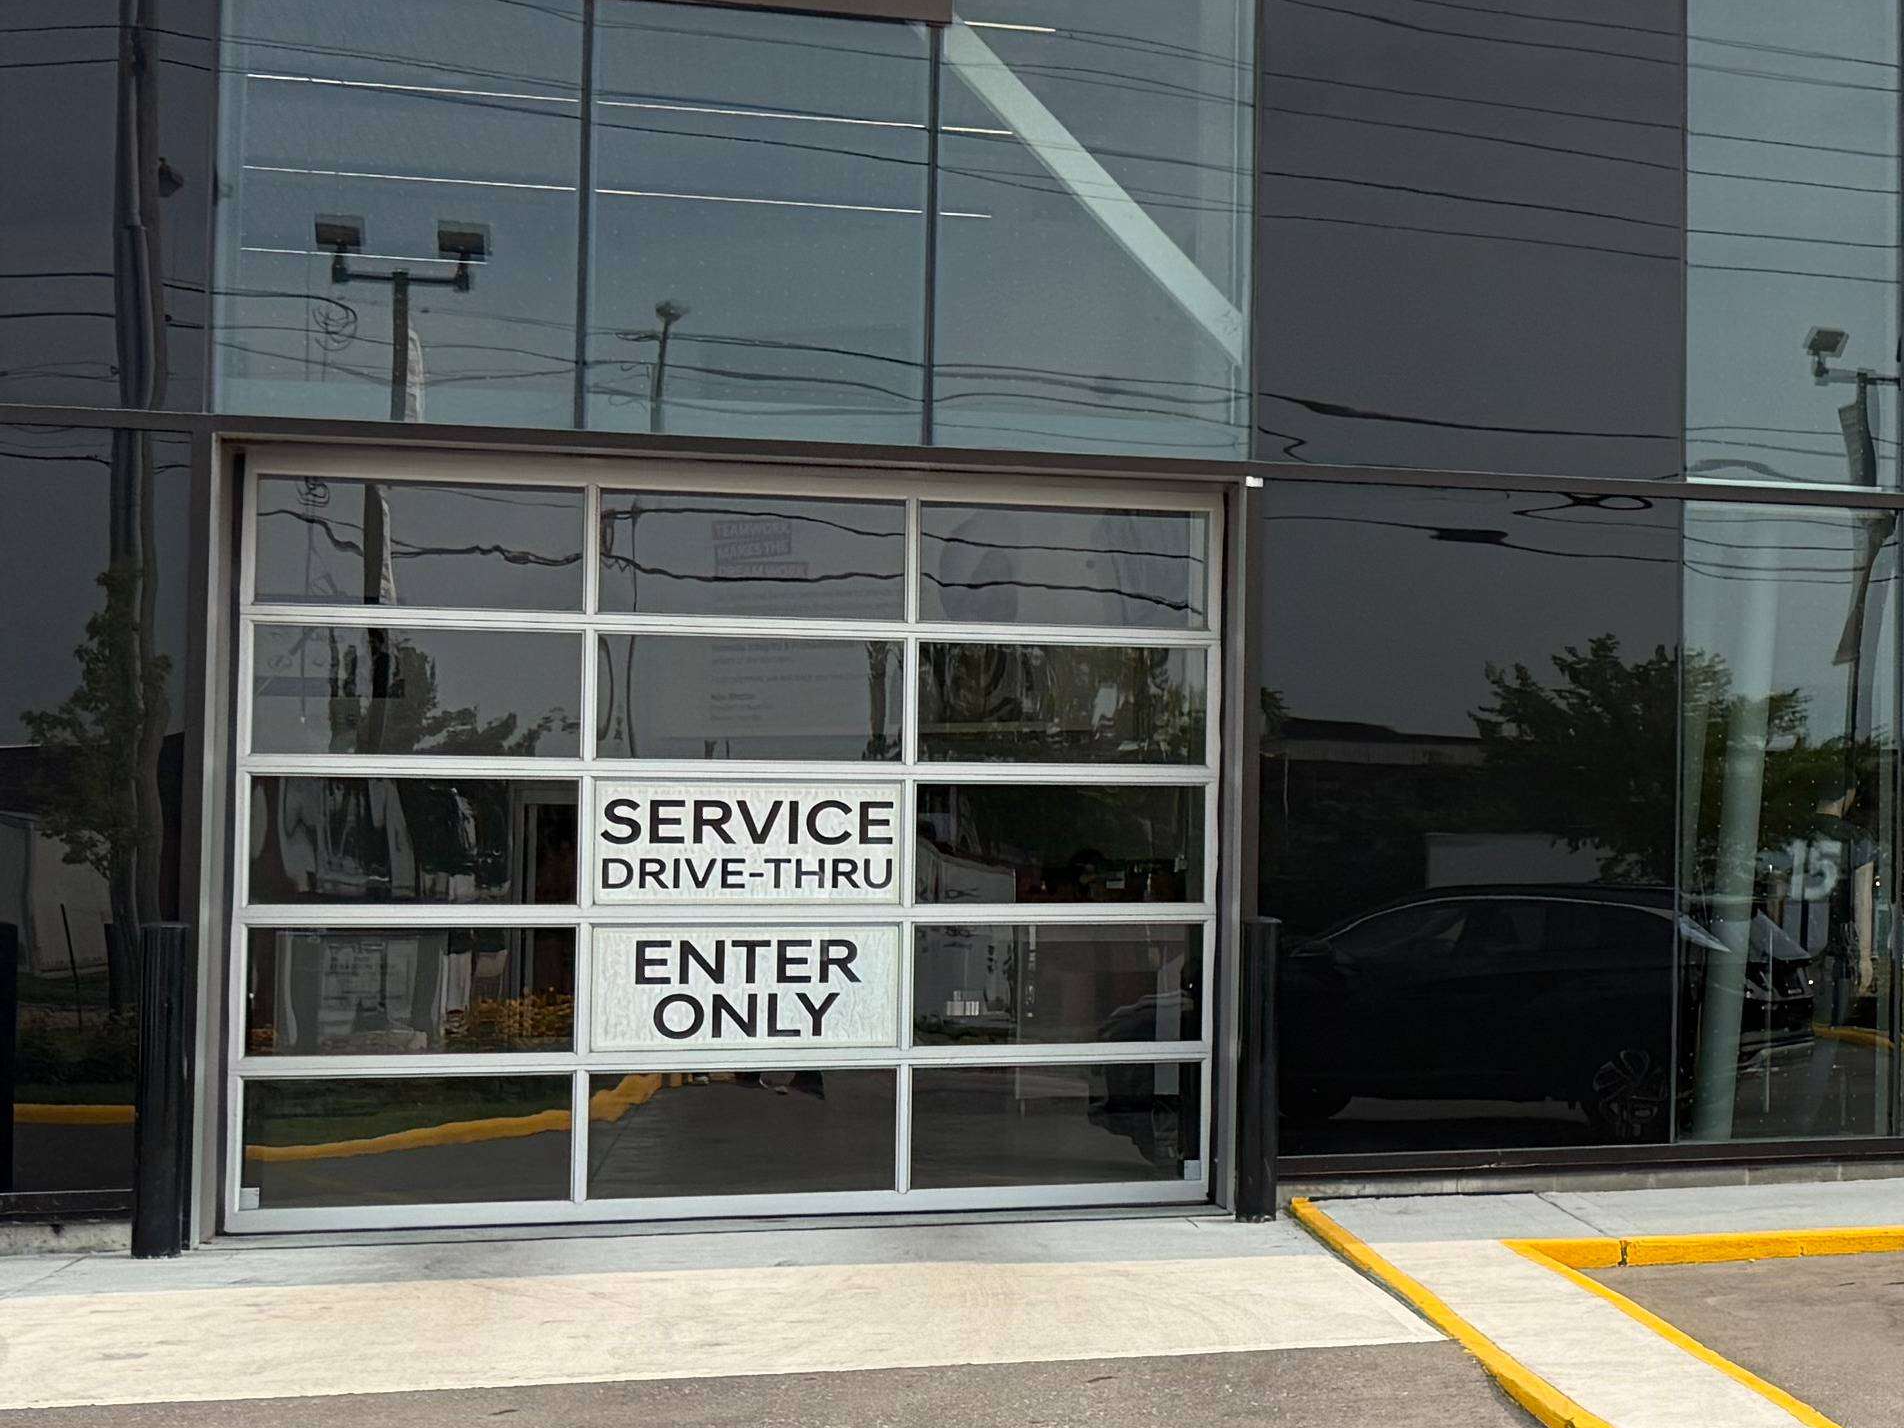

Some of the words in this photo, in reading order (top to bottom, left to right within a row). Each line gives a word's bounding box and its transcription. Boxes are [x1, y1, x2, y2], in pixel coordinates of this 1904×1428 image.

[600, 798, 894, 845] SERVICE
[601, 858, 893, 889] DRIVE-THRU
[634, 939, 862, 985] ENTER
[653, 992, 840, 1039] ONLY
